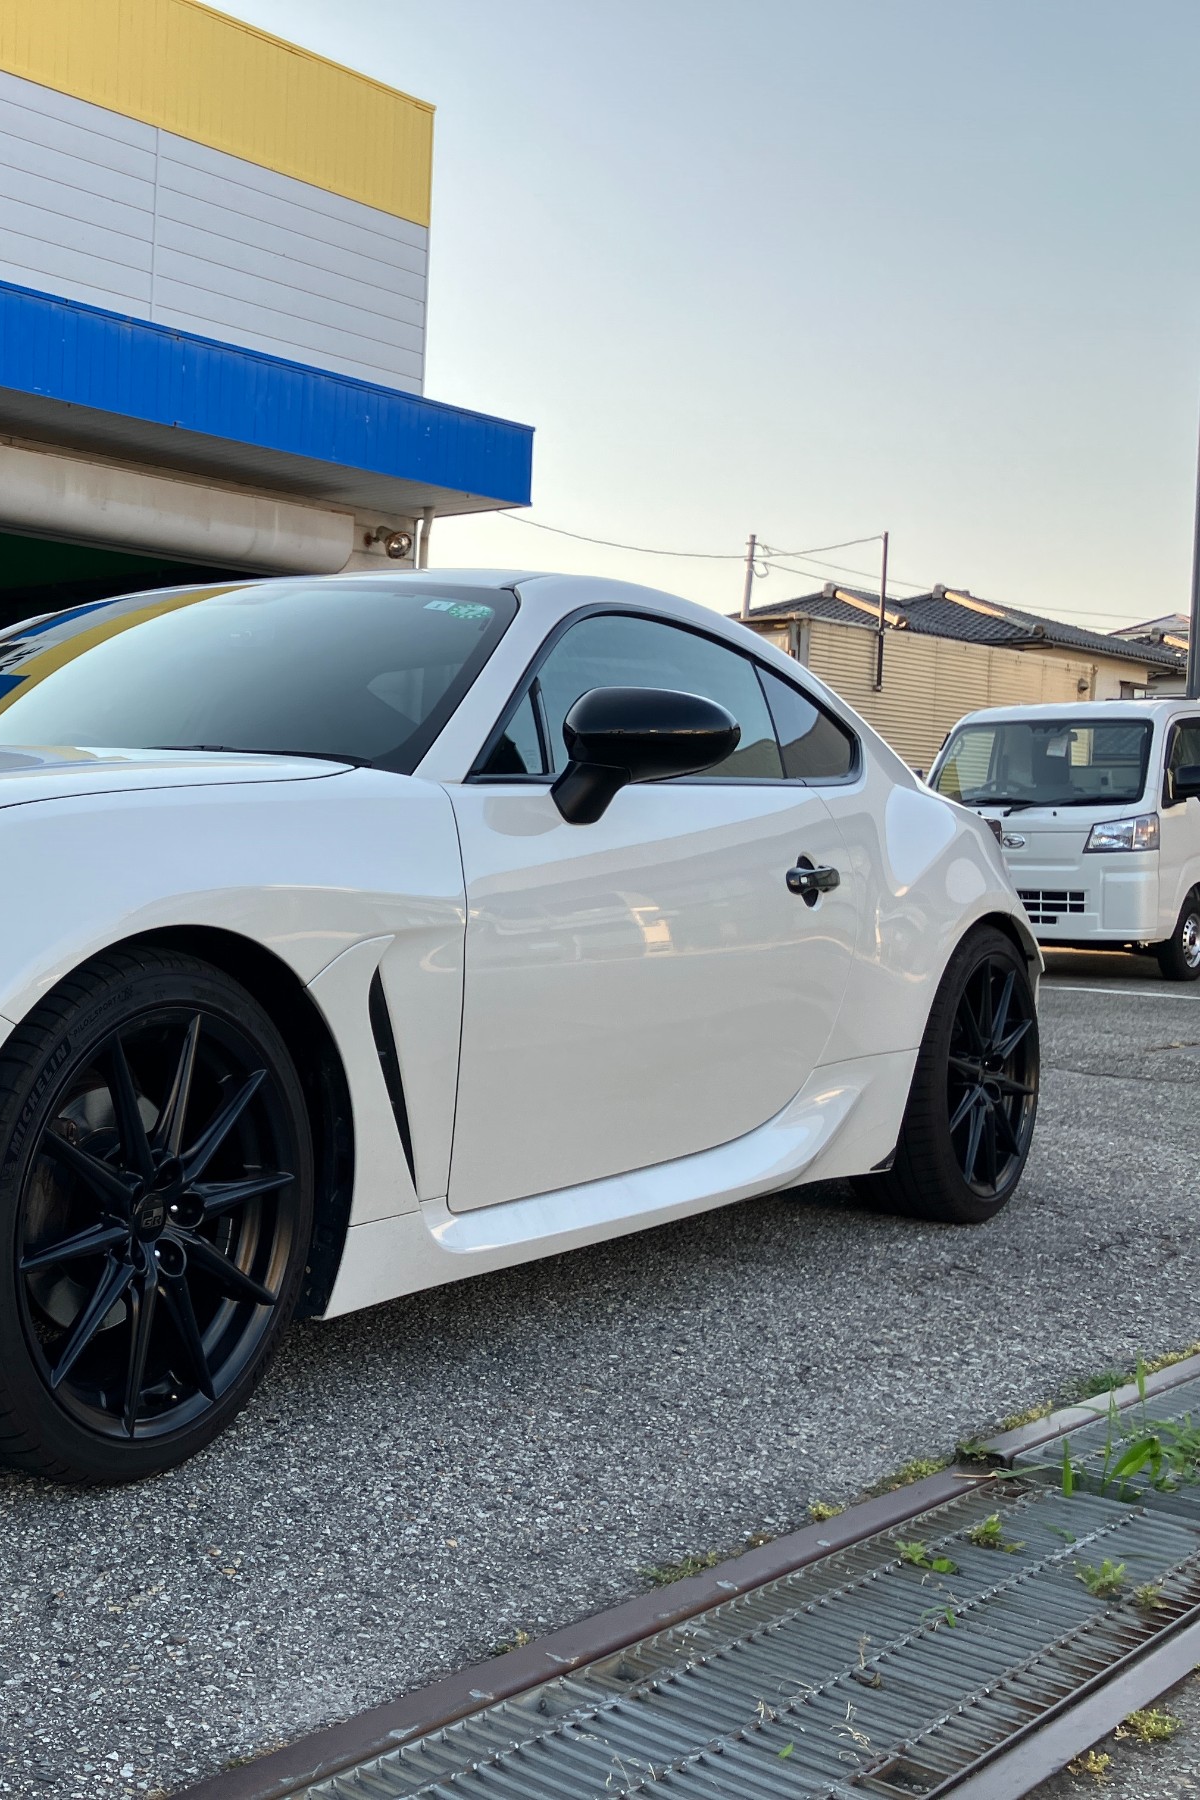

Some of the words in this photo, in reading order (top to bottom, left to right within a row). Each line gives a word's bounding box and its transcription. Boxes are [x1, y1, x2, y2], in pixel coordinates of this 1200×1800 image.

[95, 996, 117, 1017] SPORT
[10, 1043, 67, 1155] MICHELIN
[143, 1215, 162, 1228] GR
